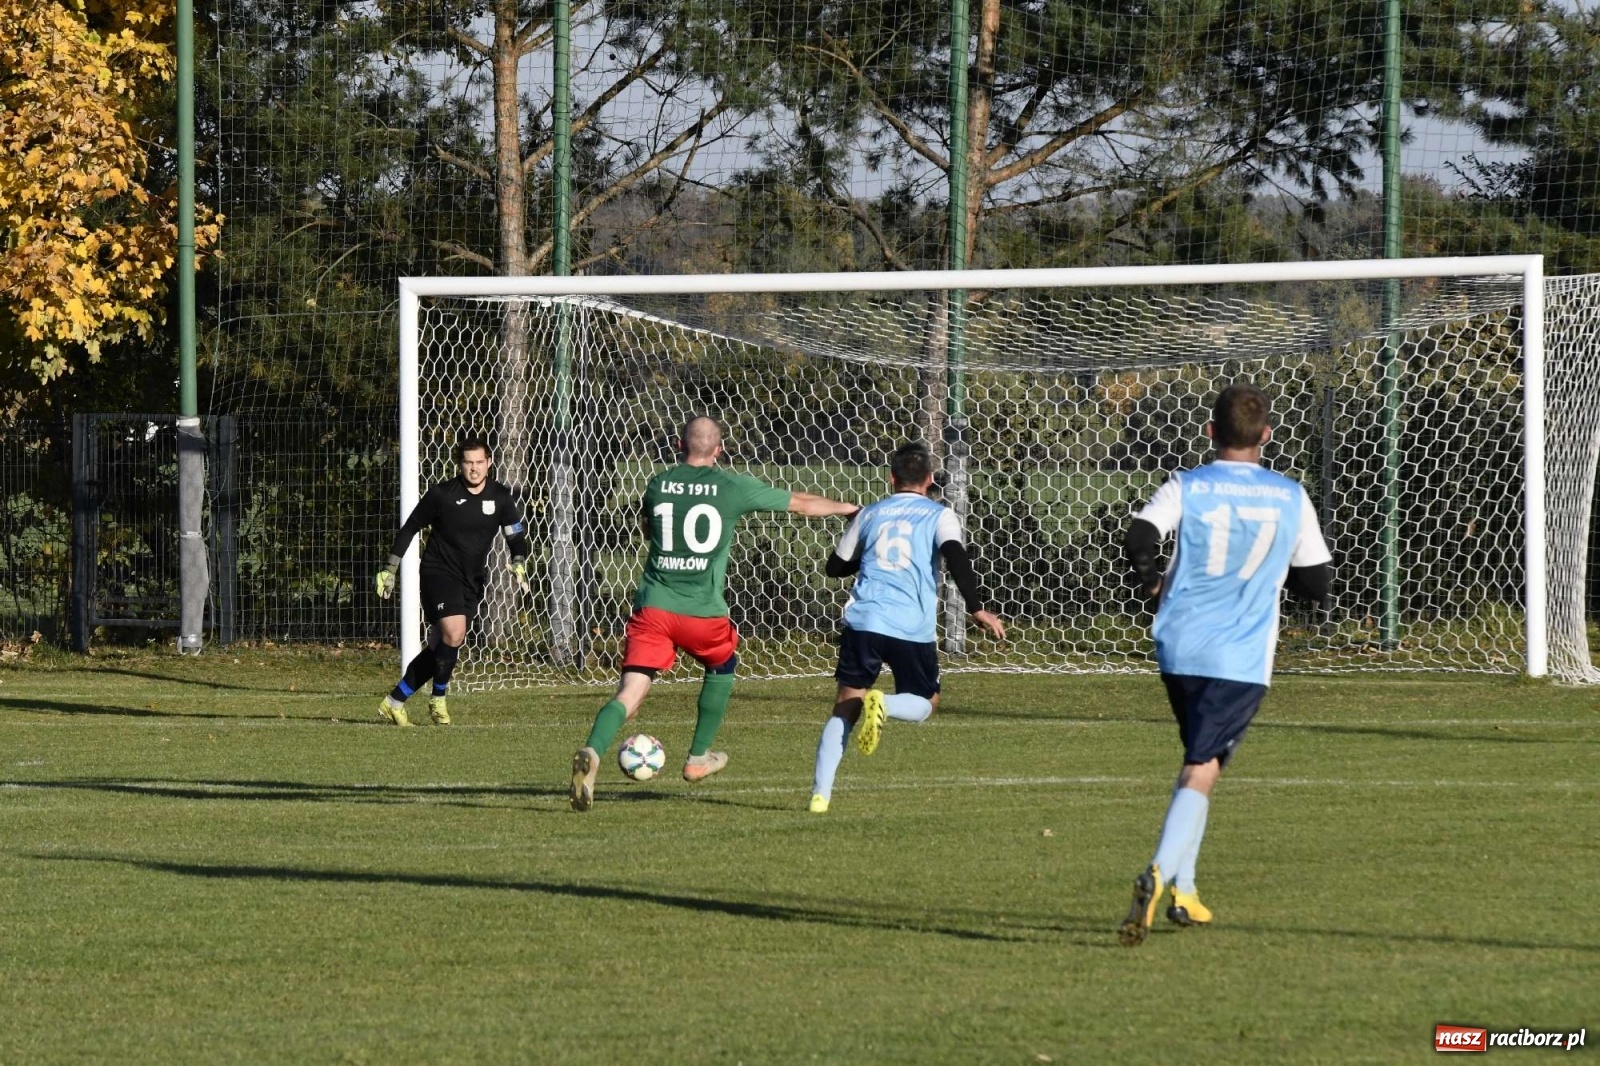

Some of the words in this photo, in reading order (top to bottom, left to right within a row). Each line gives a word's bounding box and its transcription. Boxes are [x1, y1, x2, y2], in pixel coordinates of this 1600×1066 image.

[661, 480, 685, 495] LKS
[688, 483, 718, 496] 1911
[653, 502, 723, 554] 10
[875, 519, 913, 571] 6
[1201, 503, 1280, 580] 17
[656, 555, 709, 571] PAWŁÓW
